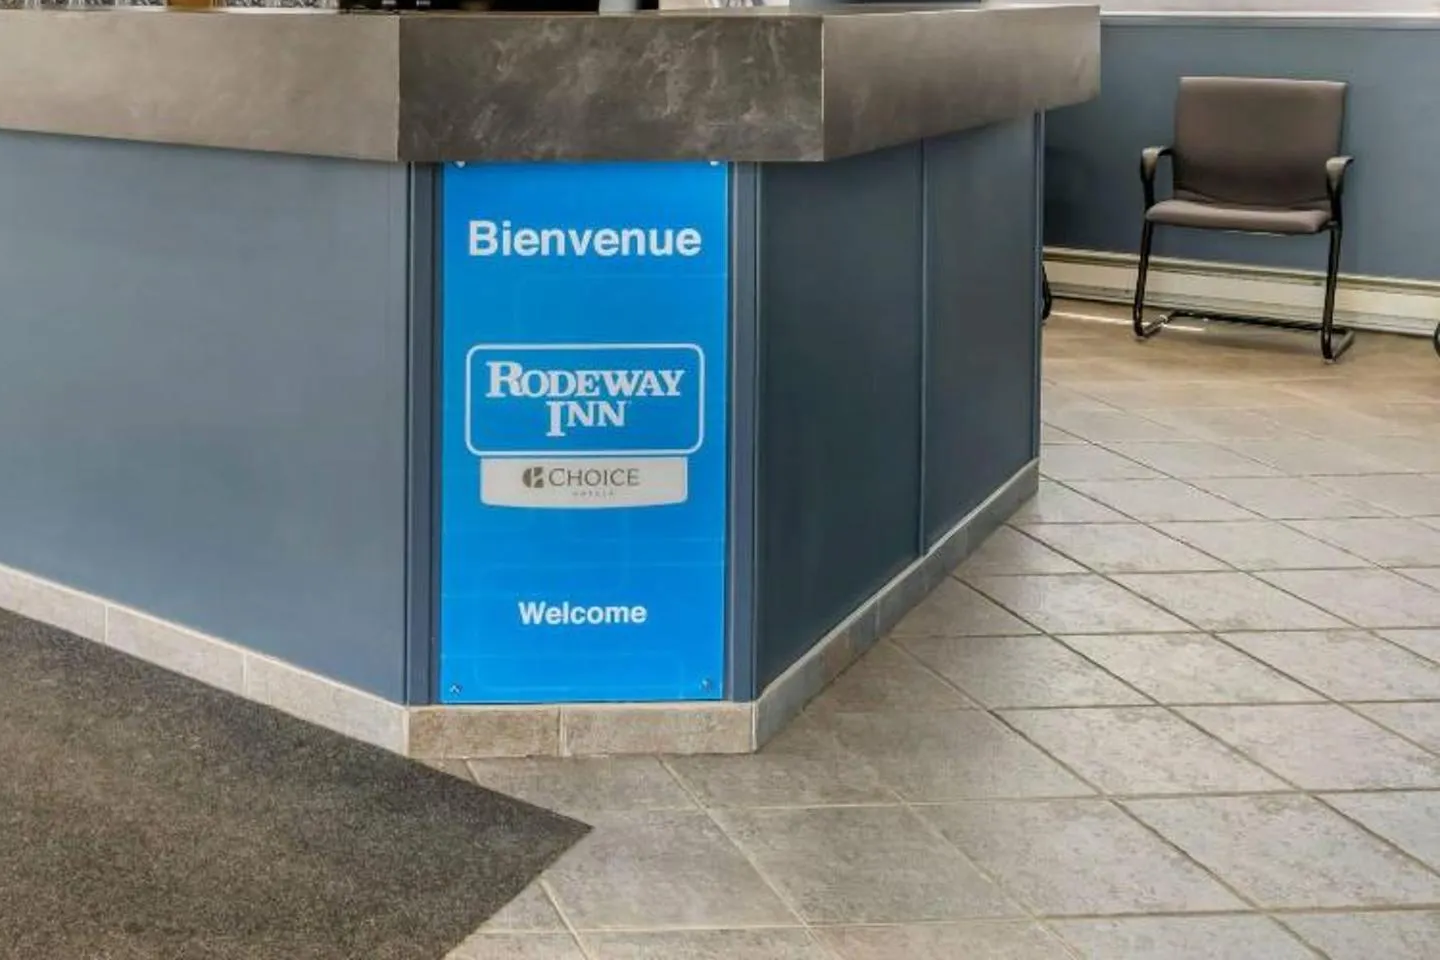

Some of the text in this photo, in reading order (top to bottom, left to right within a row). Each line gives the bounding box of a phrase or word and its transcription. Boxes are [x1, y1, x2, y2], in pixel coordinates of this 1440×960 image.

[468, 220, 702, 257] Bienvenue
[485, 361, 685, 398] RODEWAY
[545, 400, 627, 437] INN
[548, 467, 640, 487] CHOICE
[518, 602, 647, 625] Welcome
